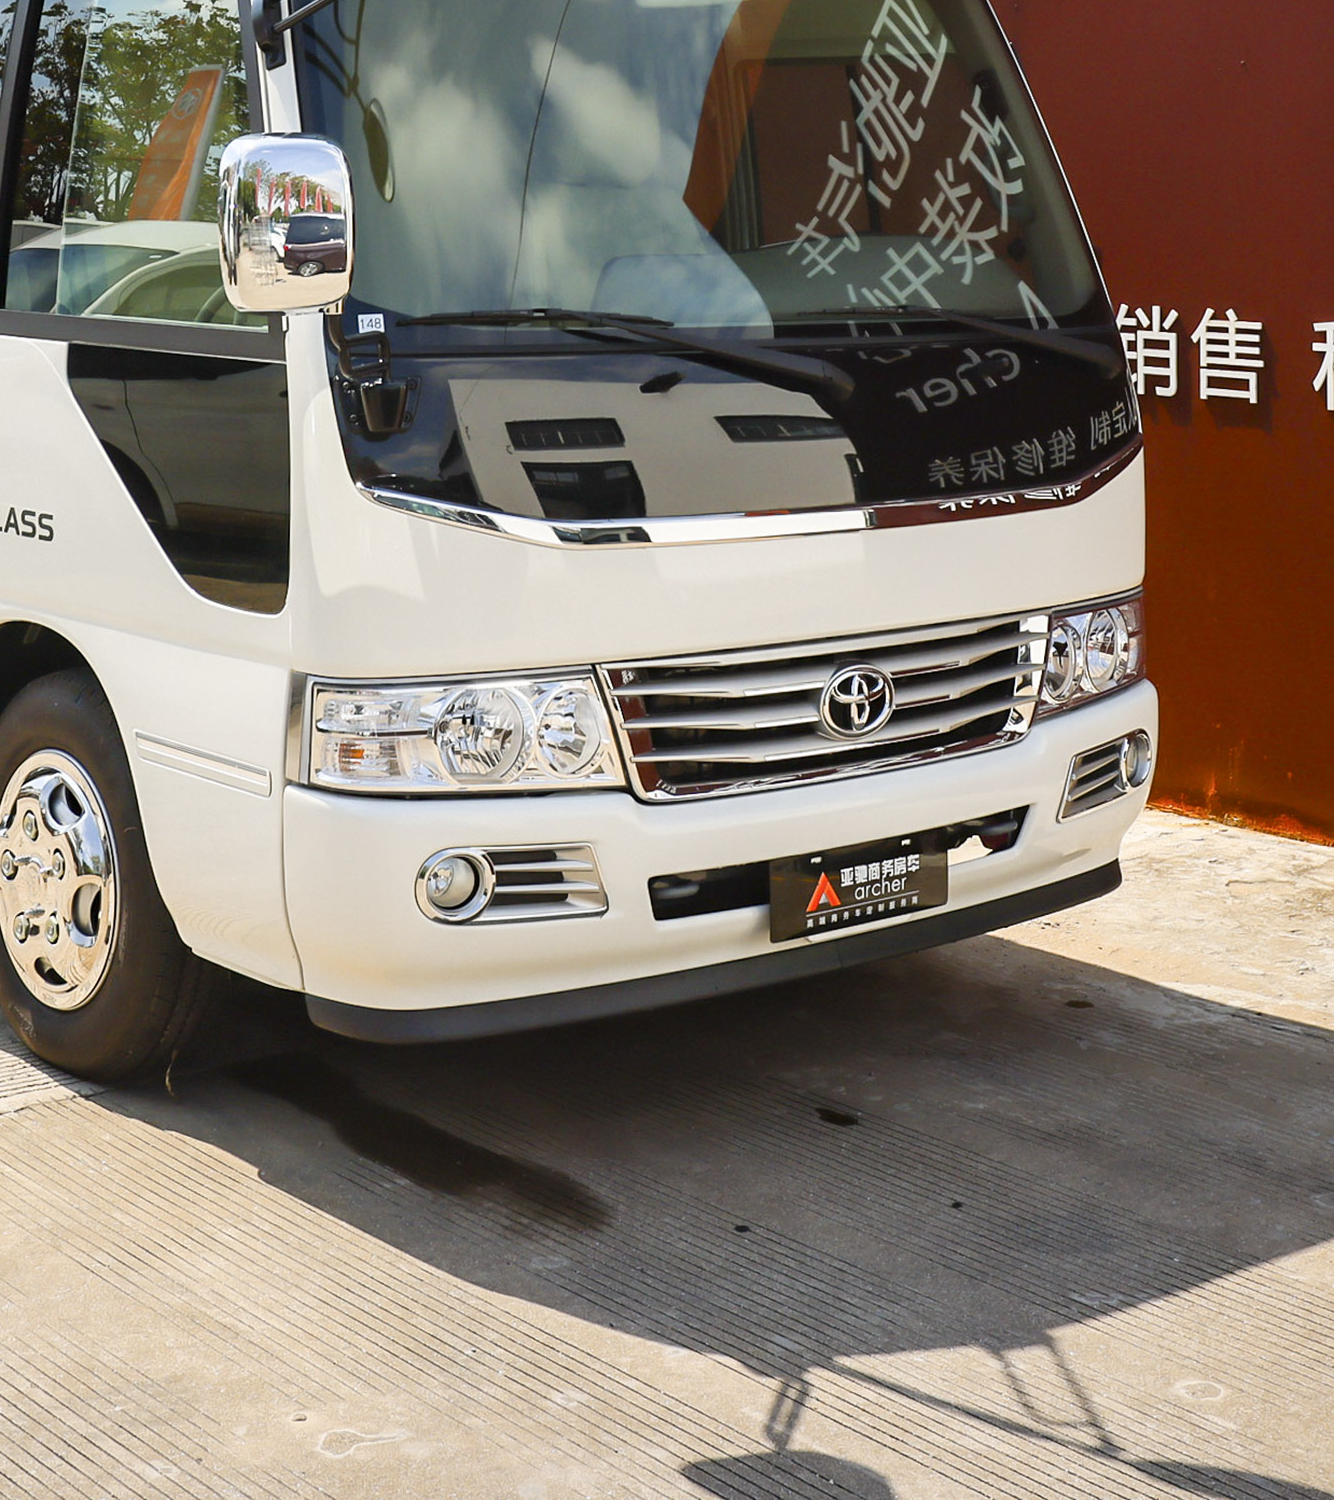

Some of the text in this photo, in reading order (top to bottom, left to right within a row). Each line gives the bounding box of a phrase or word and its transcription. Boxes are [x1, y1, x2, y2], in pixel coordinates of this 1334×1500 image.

[359, 317, 382, 331] 148
[1115, 303, 1265, 404] 销售
[840, 854, 920, 888] 亚驰商务房车
[854, 877, 908, 900] archer
